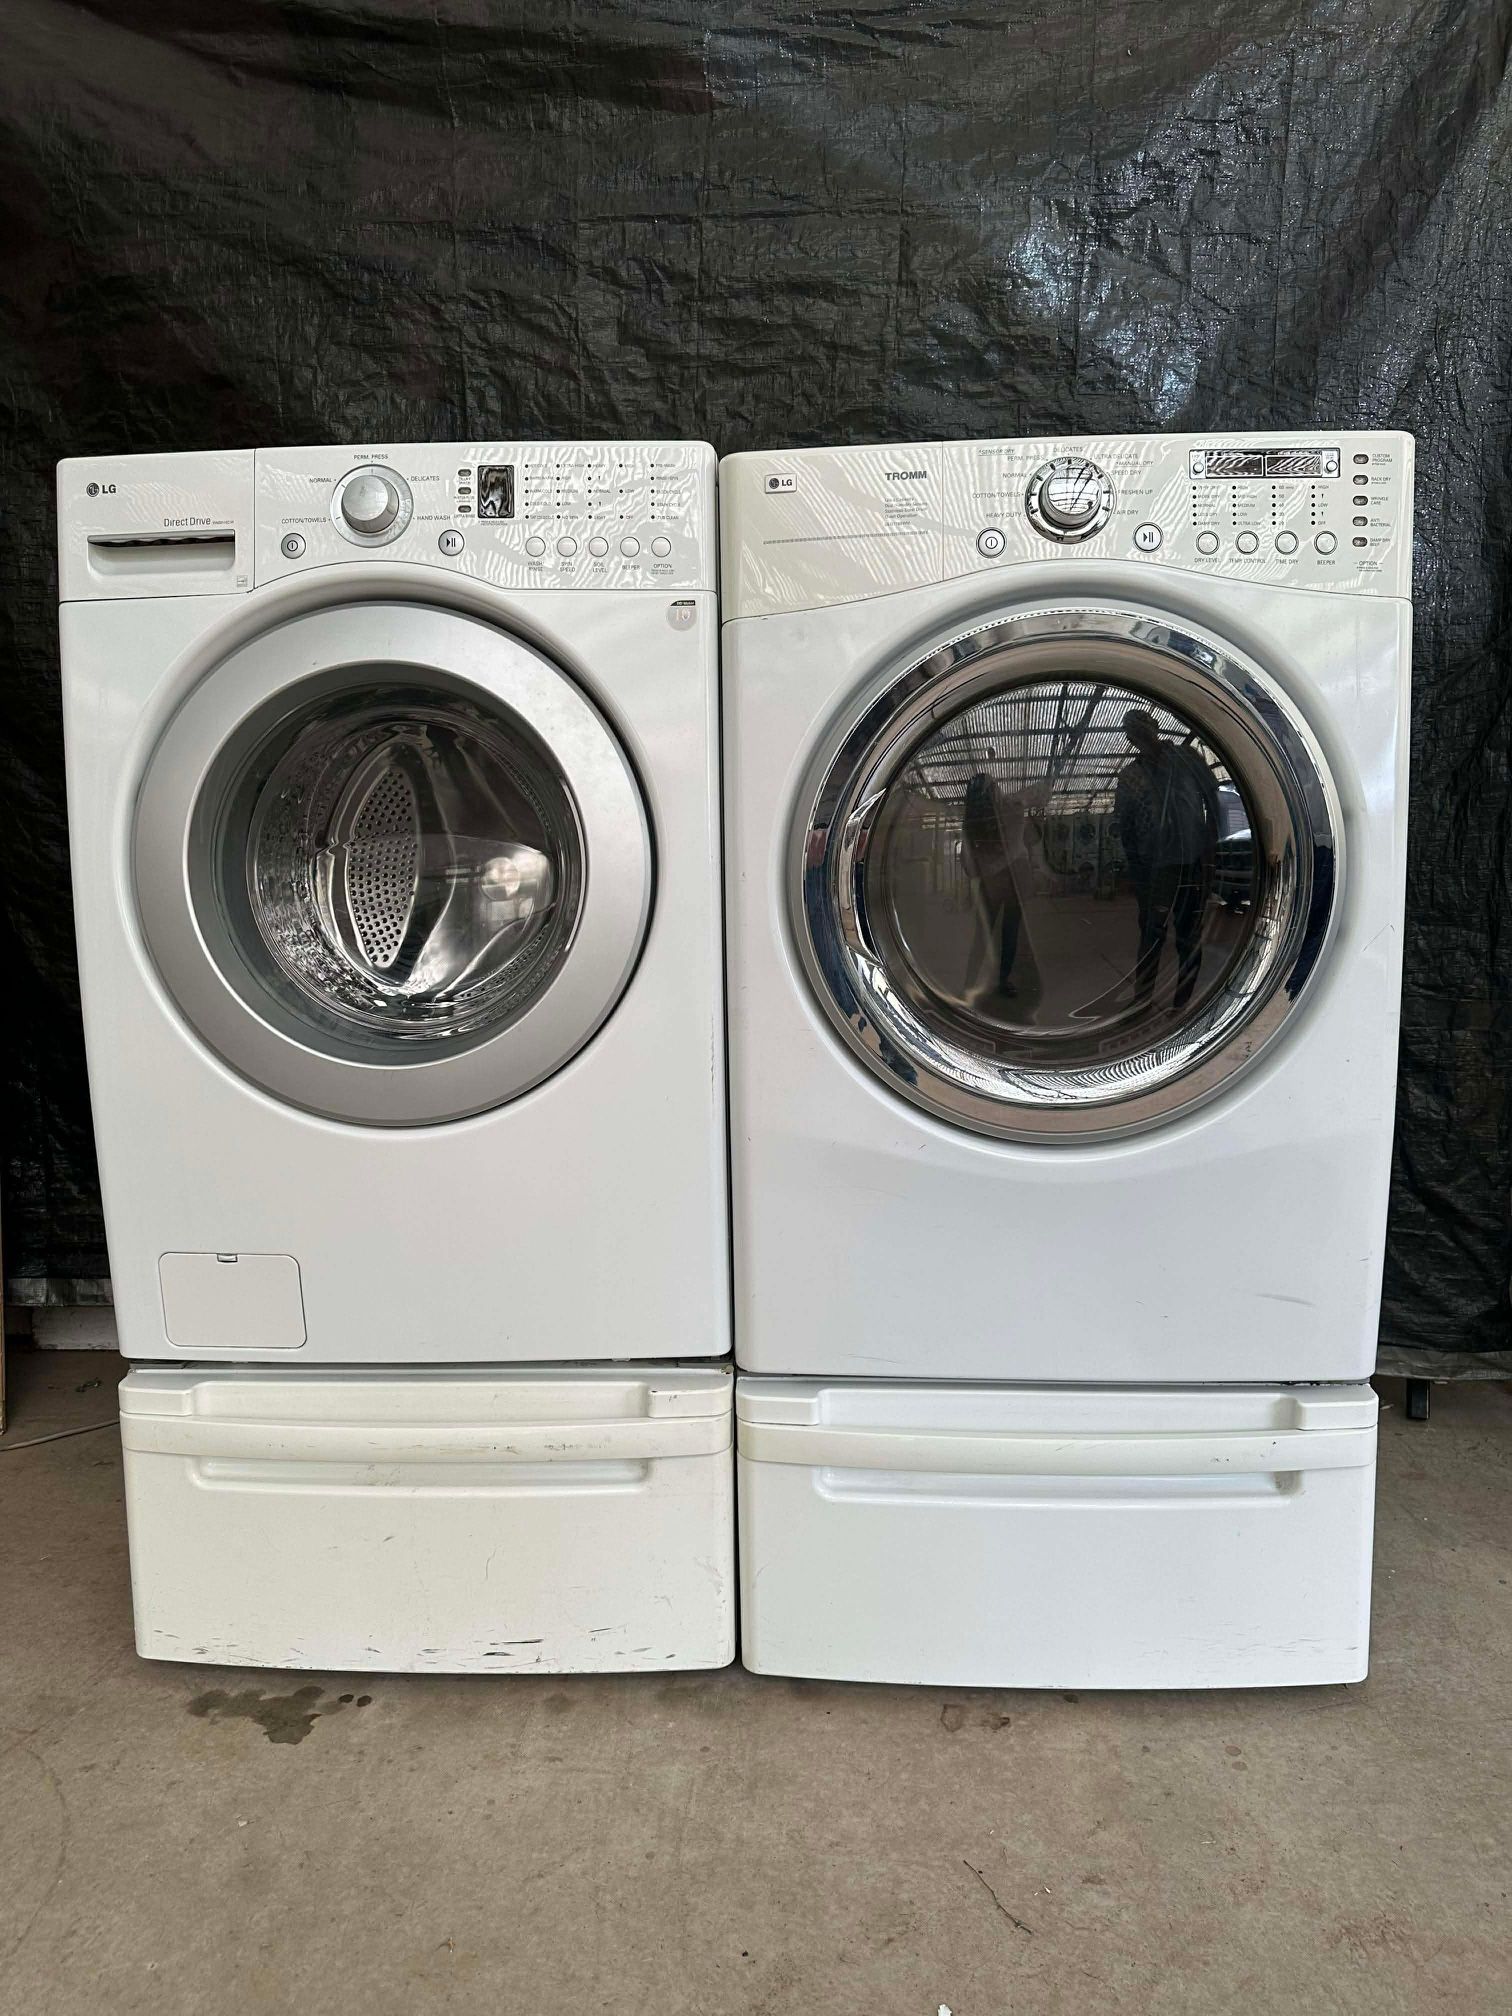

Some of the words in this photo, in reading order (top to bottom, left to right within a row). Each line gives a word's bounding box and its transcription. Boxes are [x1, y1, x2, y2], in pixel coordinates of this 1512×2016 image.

[884, 470, 927, 480] TROMM
[102, 484, 117, 494] LG
[164, 518, 188, 527] Direct
[190, 517, 211, 526] Drive
